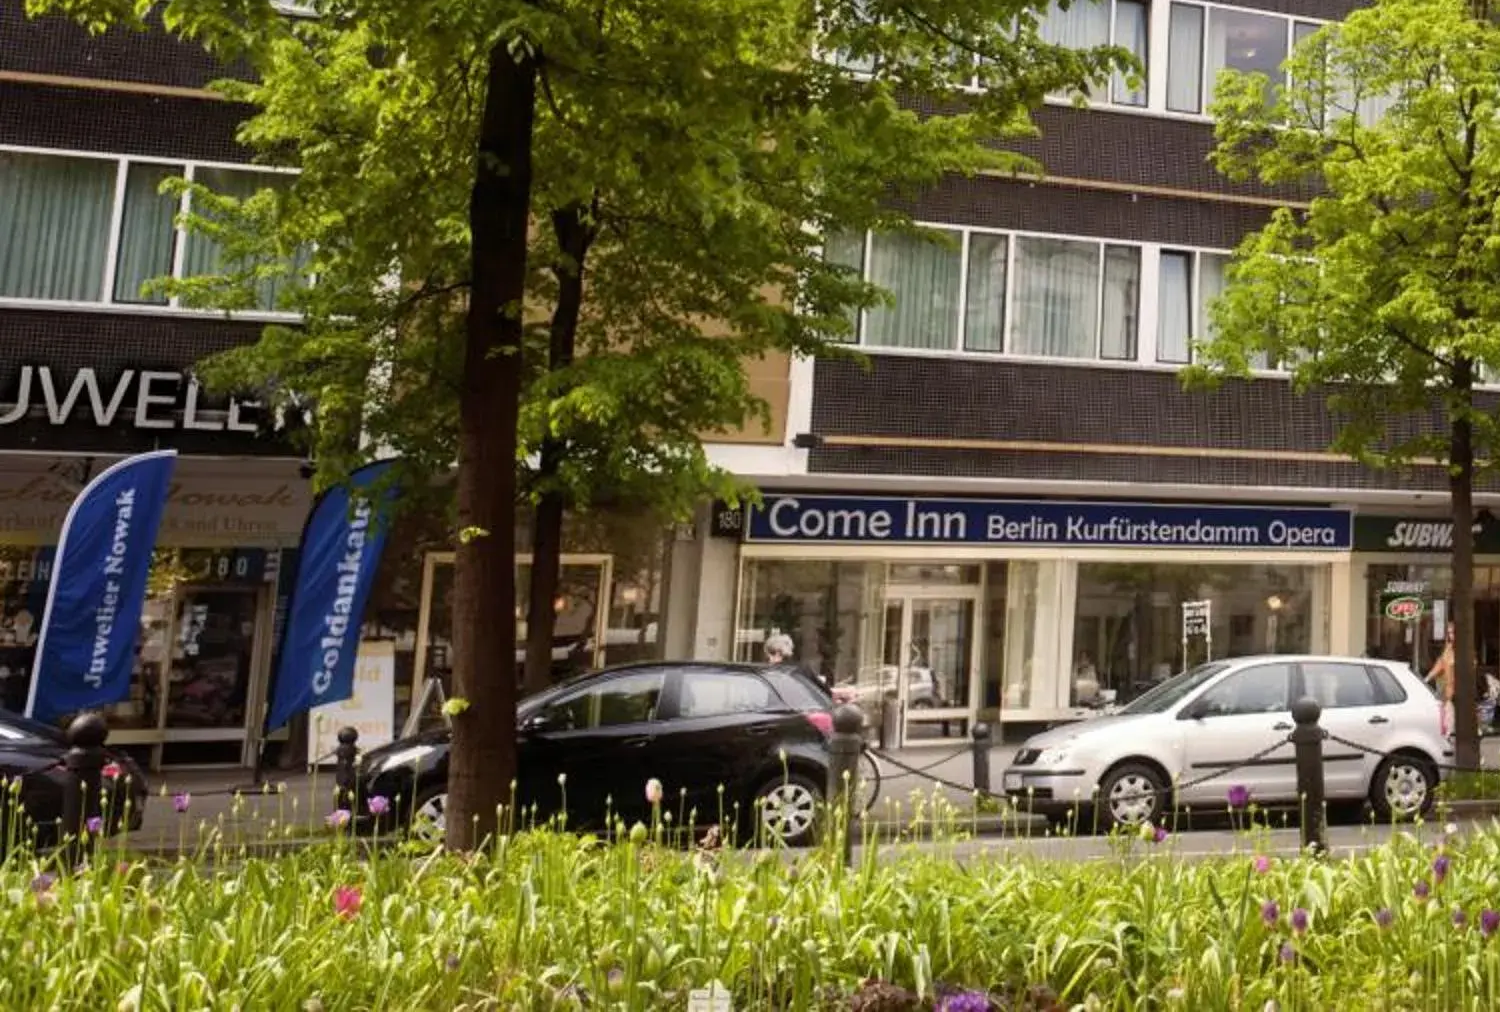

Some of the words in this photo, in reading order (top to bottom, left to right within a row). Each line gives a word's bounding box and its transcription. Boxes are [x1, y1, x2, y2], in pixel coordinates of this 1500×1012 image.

[719, 512, 742, 530] 180
[769, 498, 893, 537] Come
[904, 501, 967, 539] Inn
[987, 515, 1057, 540] Berlin
[1067, 516, 1259, 544] Kurfürstendamm
[1268, 520, 1336, 548] Opera
[1387, 522, 1483, 547] SUBW
[84, 580, 120, 689] Juwelier
[104, 488, 136, 576] Nowak
